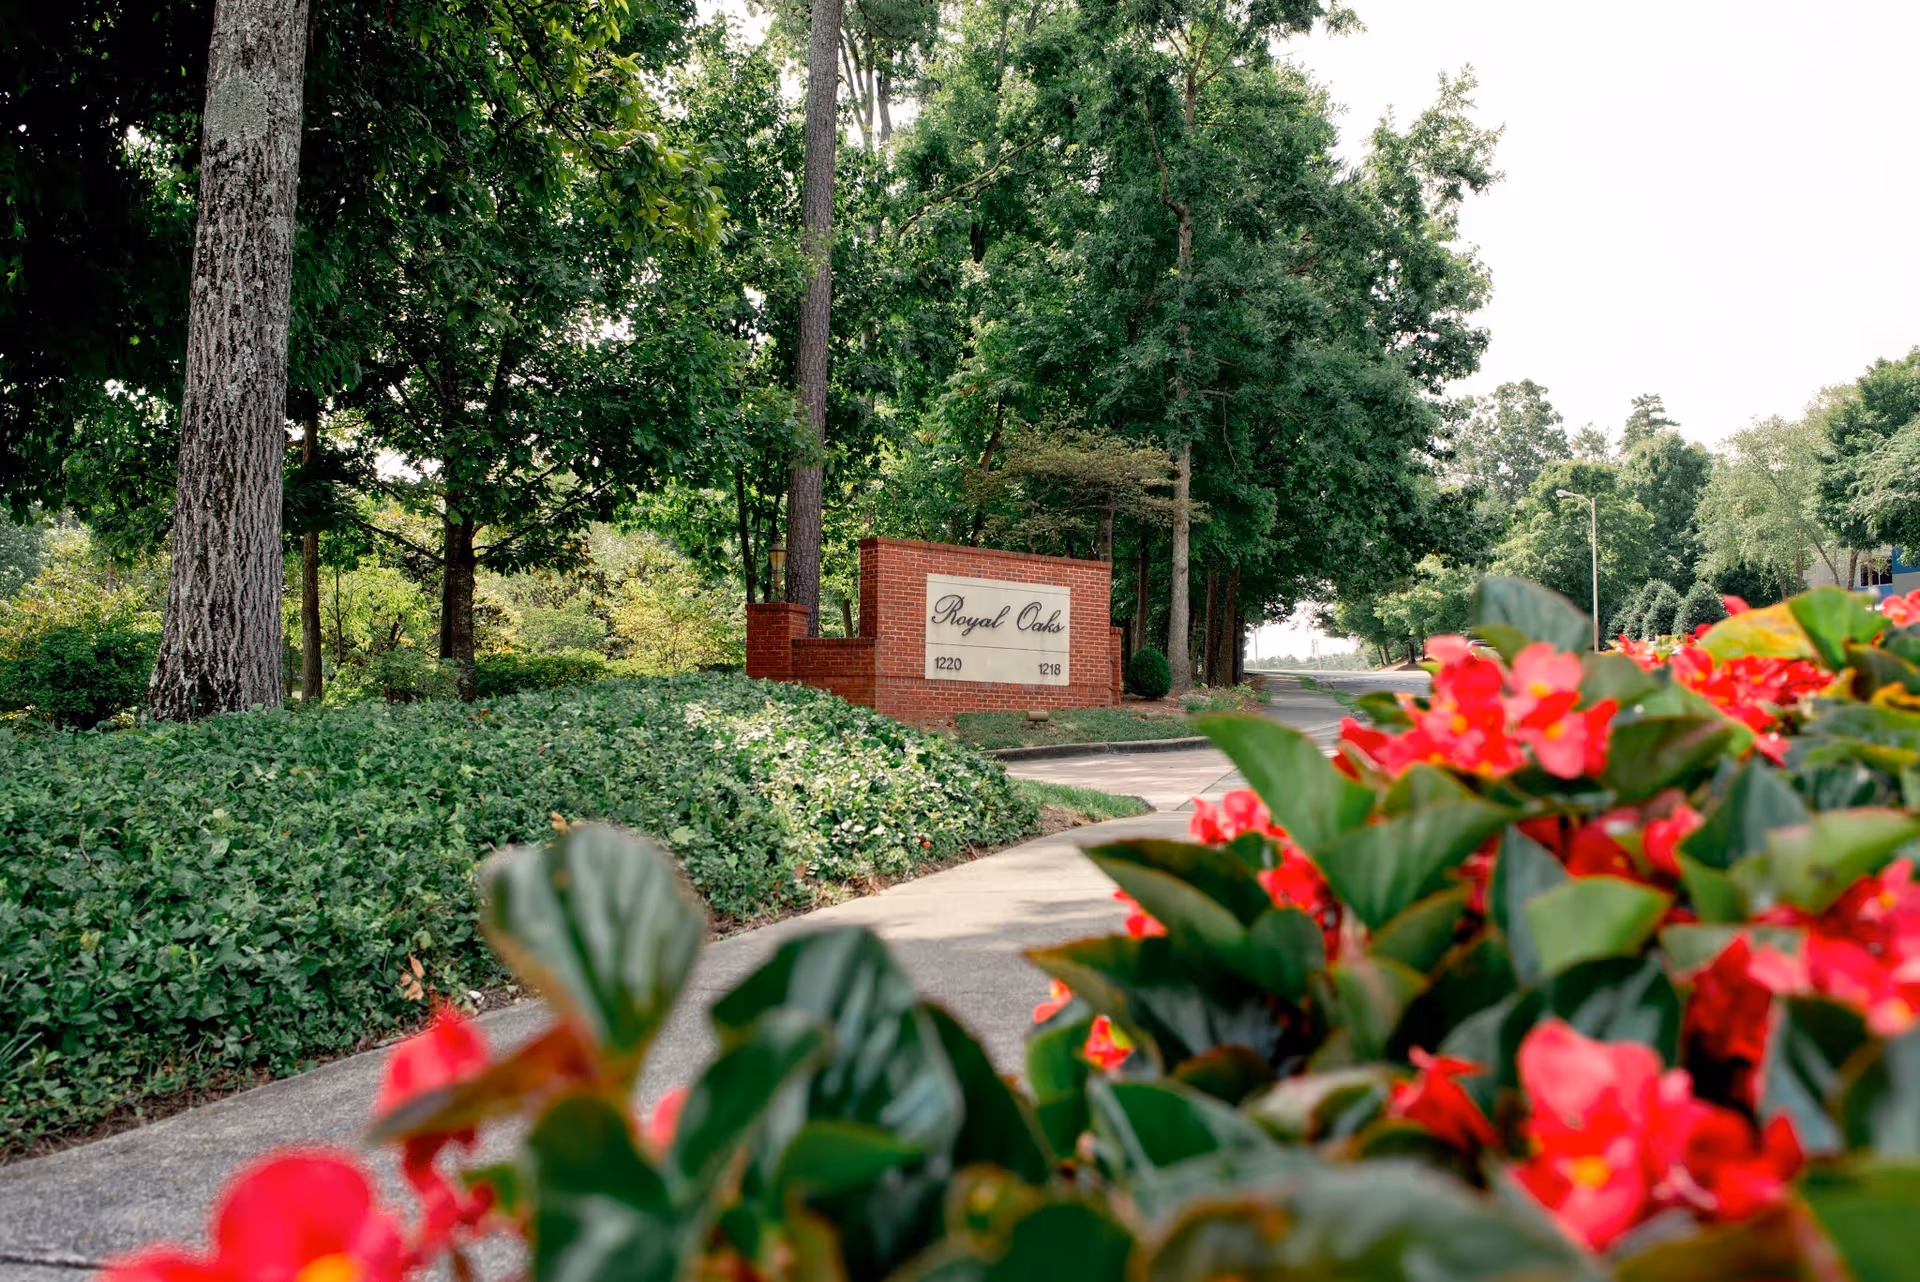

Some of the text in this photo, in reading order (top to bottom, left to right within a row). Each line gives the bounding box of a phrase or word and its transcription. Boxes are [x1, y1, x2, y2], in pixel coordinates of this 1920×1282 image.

[931, 594, 1065, 636] Royal Oaks
[934, 656, 962, 671] 1220
[1038, 662, 1061, 676] 1218
